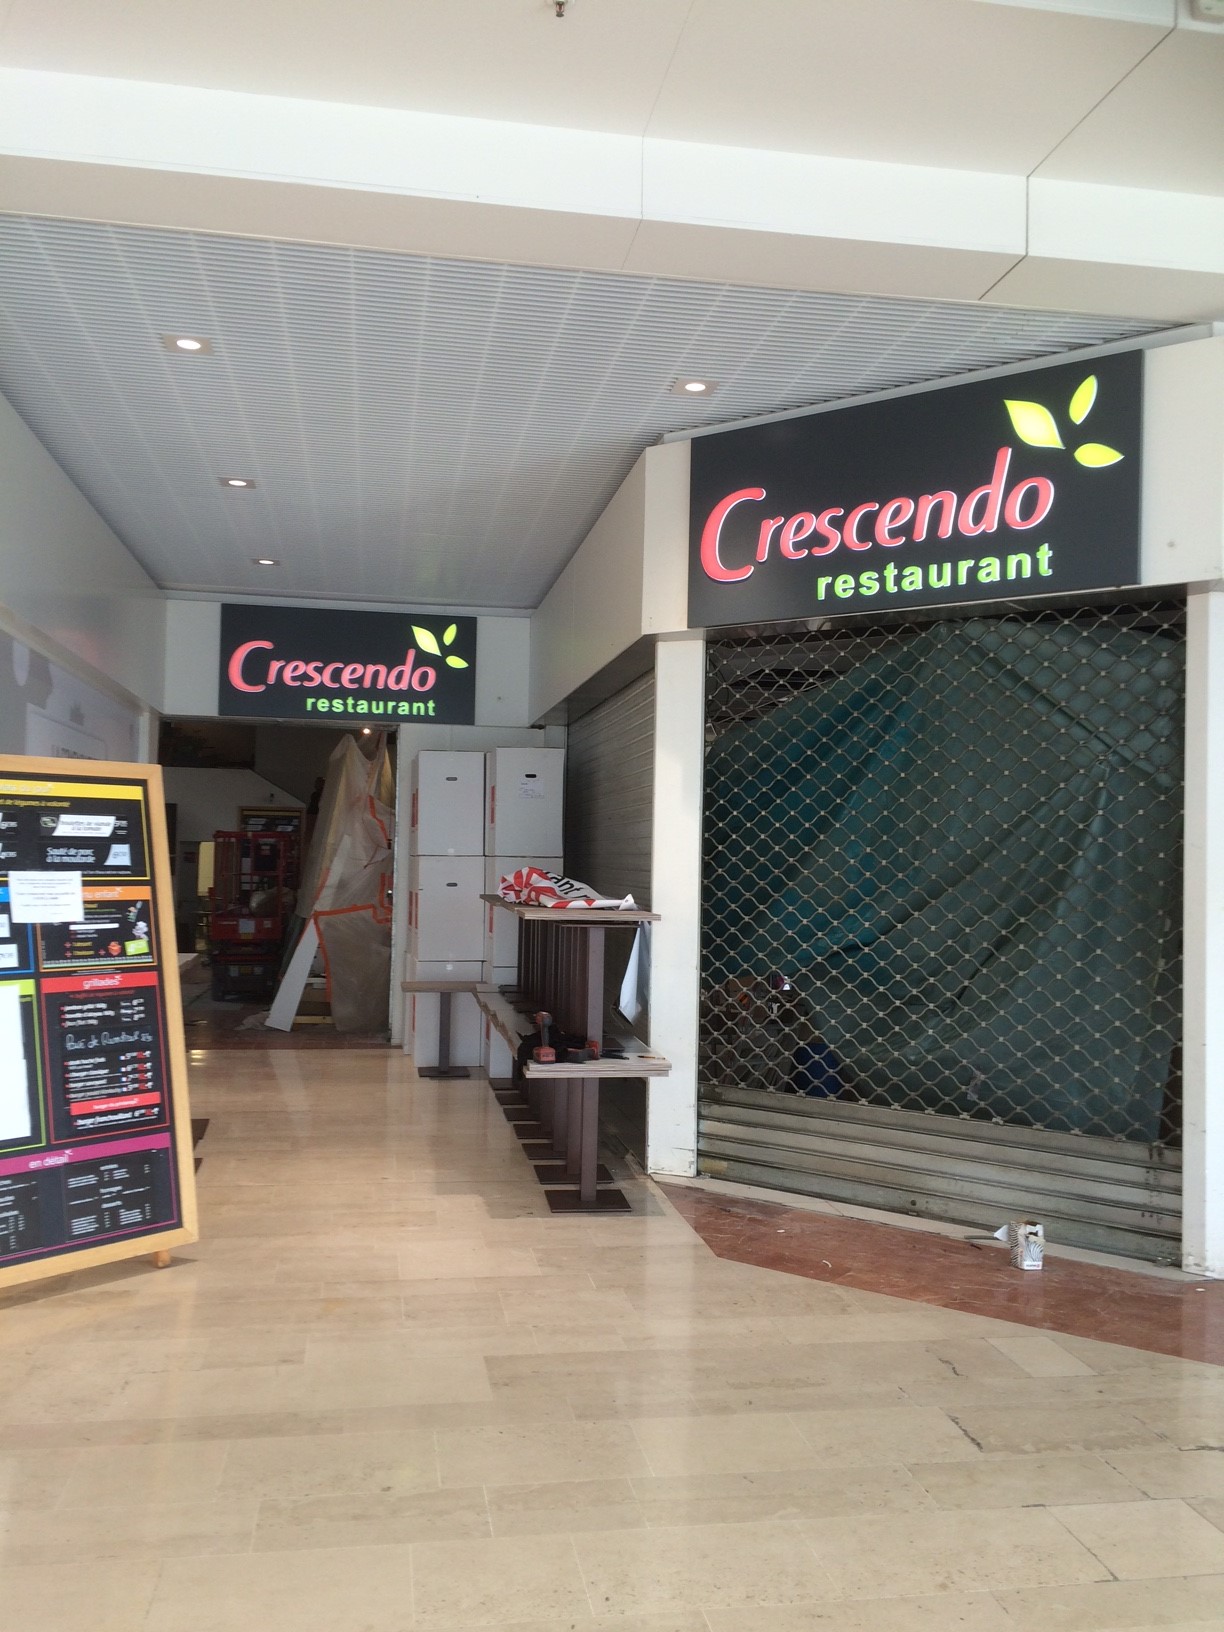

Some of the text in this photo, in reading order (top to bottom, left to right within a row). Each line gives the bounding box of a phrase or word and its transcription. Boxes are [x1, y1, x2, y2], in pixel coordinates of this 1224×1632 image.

[700, 446, 1055, 582] Crescendo
[817, 543, 1054, 600] restaurant
[228, 640, 437, 693] Crescendo
[306, 696, 436, 717] restaurant
